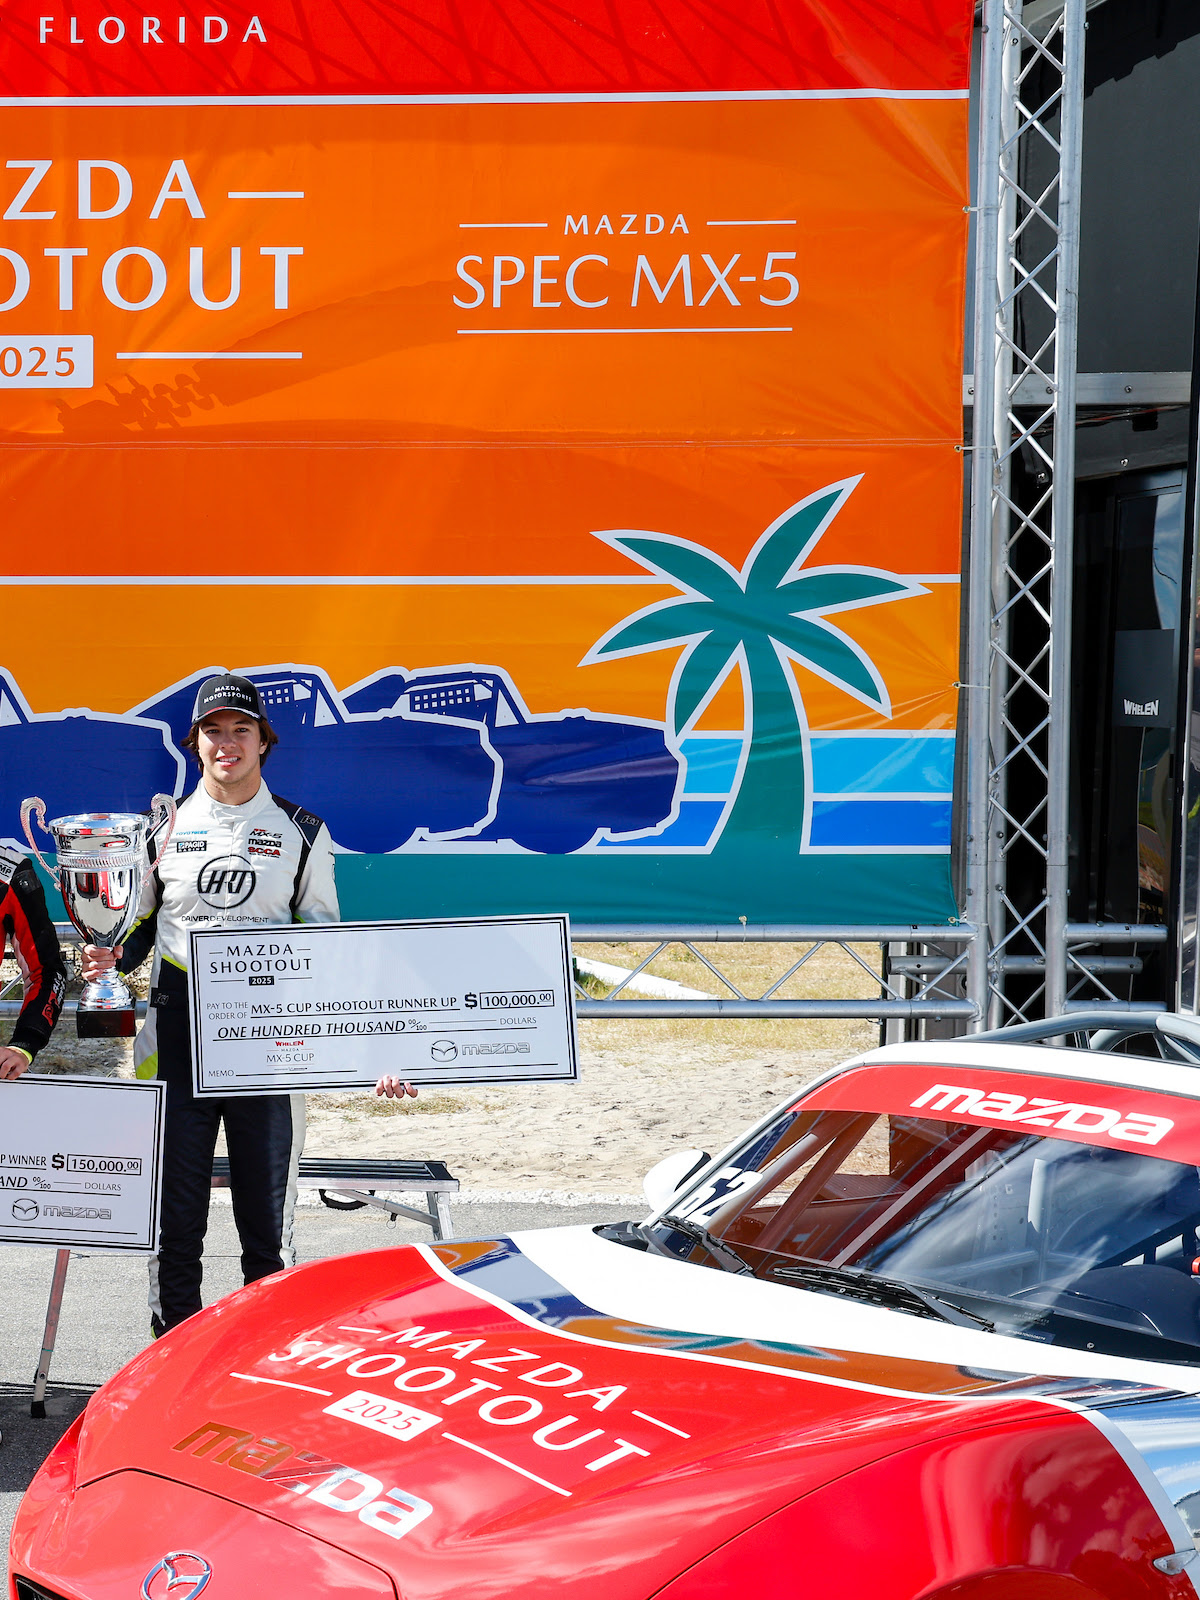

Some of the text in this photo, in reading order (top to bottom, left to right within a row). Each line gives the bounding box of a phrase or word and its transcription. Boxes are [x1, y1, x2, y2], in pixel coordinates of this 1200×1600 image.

[39, 16, 267, 44] FLORIDA
[564, 213, 690, 236] MAZDA
[453, 252, 800, 309] SPEC MX-5
[204, 692, 252, 703] MOTORSPORTS
[1124, 699, 1159, 715] WHELEN
[248, 839, 282, 848] mazda
[248, 847, 281, 856] SCCA
[227, 944, 293, 957] MAZDA
[210, 959, 311, 974] SHOOTOUT
[251, 977, 272, 985] 2025
[251, 997, 457, 1014] MX-5 CUP SHOOTOUT RUNNER UP
[464, 992, 552, 1009] $ 100,000.00
[209, 1012, 235, 1020] ORDER
[500, 1017, 537, 1025] DOLLARS
[218, 1026, 247, 1038] ONE
[251, 1023, 322, 1037] HUNDRED
[326, 1020, 406, 1034] THOUSAND
[461, 1042, 531, 1056] mazda
[266, 1053, 315, 1063] MX-5 CUP
[910, 1084, 1175, 1146] mazda
[9, 1154, 47, 1166] WINNER
[52, 1153, 139, 1172] $ 150,000.00
[85, 1182, 121, 1191] DOLLARS
[43, 1205, 111, 1220] mazda
[392, 1326, 629, 1412] MAZDA
[268, 1340, 651, 1472] SHOOTOUT
[342, 1397, 423, 1432] 2025
[172, 1421, 434, 1540] mazda
